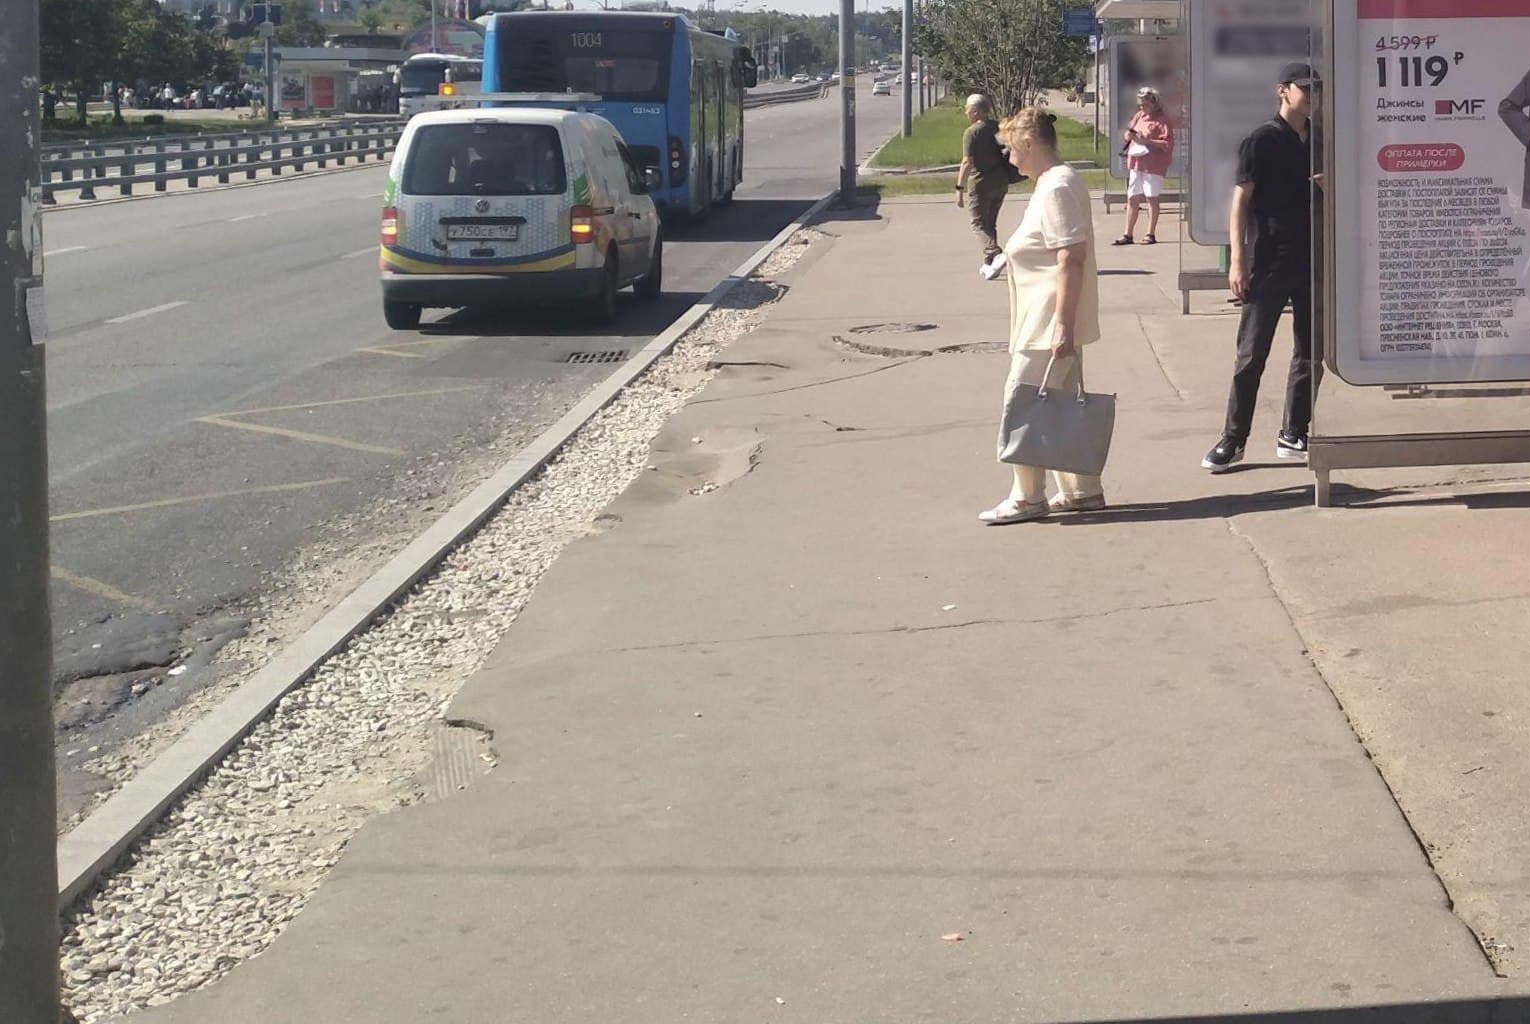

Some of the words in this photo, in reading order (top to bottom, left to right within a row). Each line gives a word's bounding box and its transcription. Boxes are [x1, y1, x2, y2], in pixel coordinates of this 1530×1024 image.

[571, 32, 602, 48] 1004
[1376, 97, 1425, 109] Джинсы
[1376, 114, 1426, 123] женские
[1384, 149, 1423, 158] ОПЛАТА
[1424, 148, 1457, 157] ПОСЛЕ
[1395, 159, 1447, 169] ПРИМЕРКИ
